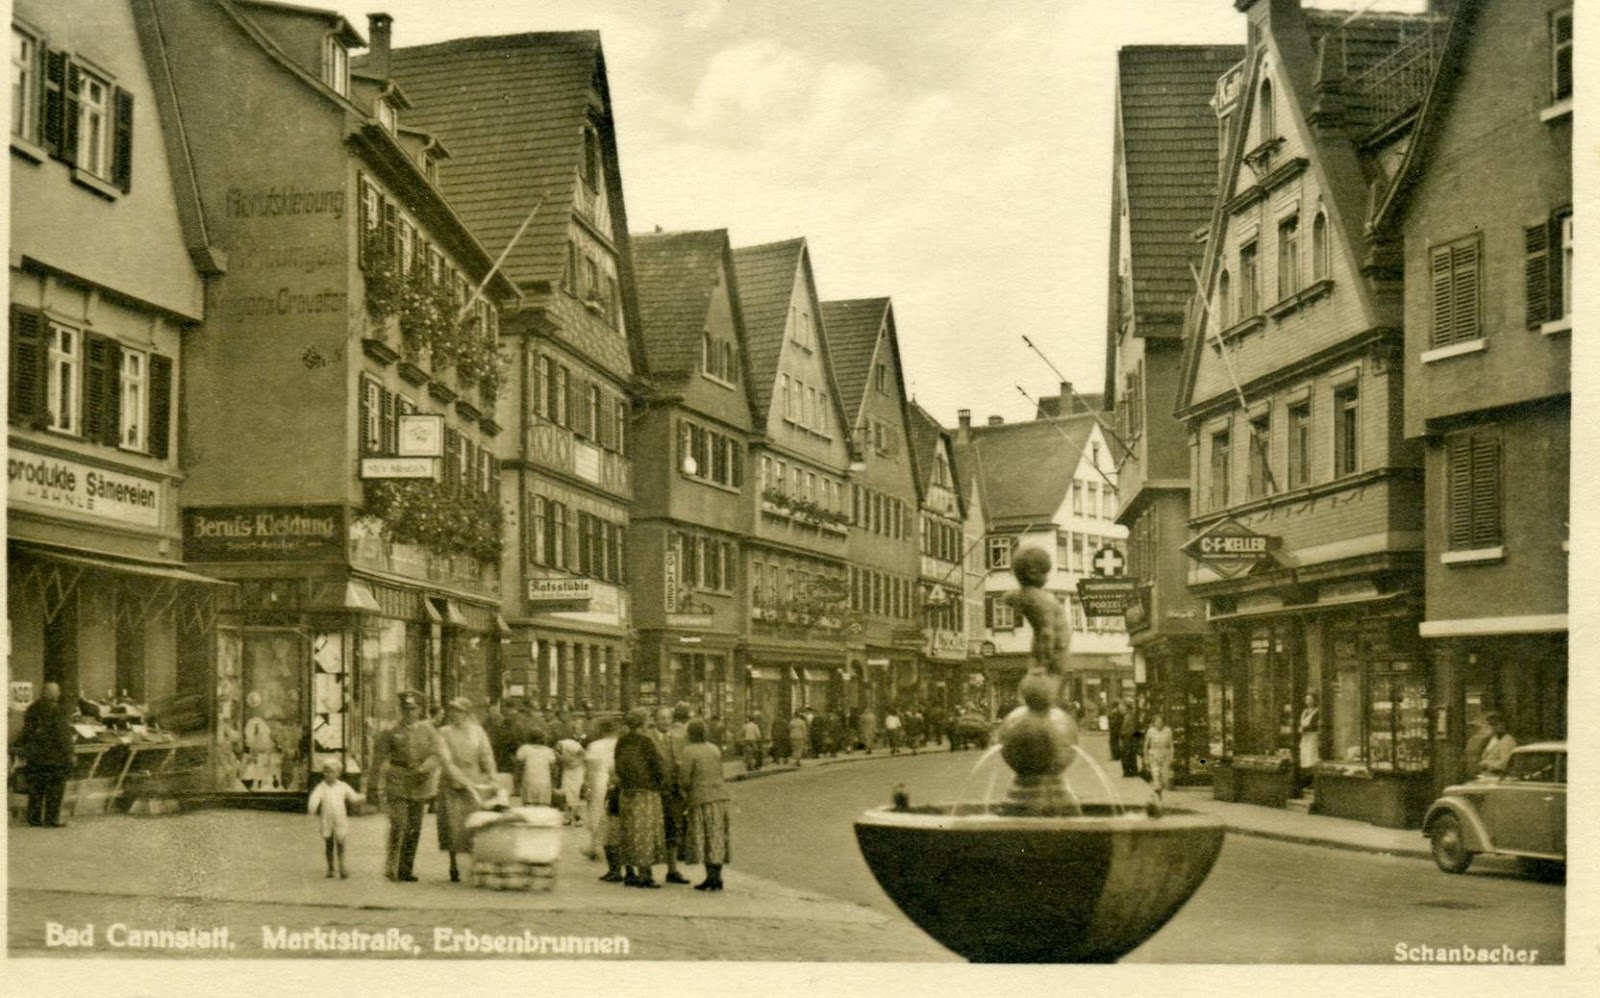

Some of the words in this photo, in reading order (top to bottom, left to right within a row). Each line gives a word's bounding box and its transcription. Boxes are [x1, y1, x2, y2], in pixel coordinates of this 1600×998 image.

[10, 459, 76, 492] produkte
[86, 471, 157, 510] Sämereien
[667, 556, 675, 611] GLASER
